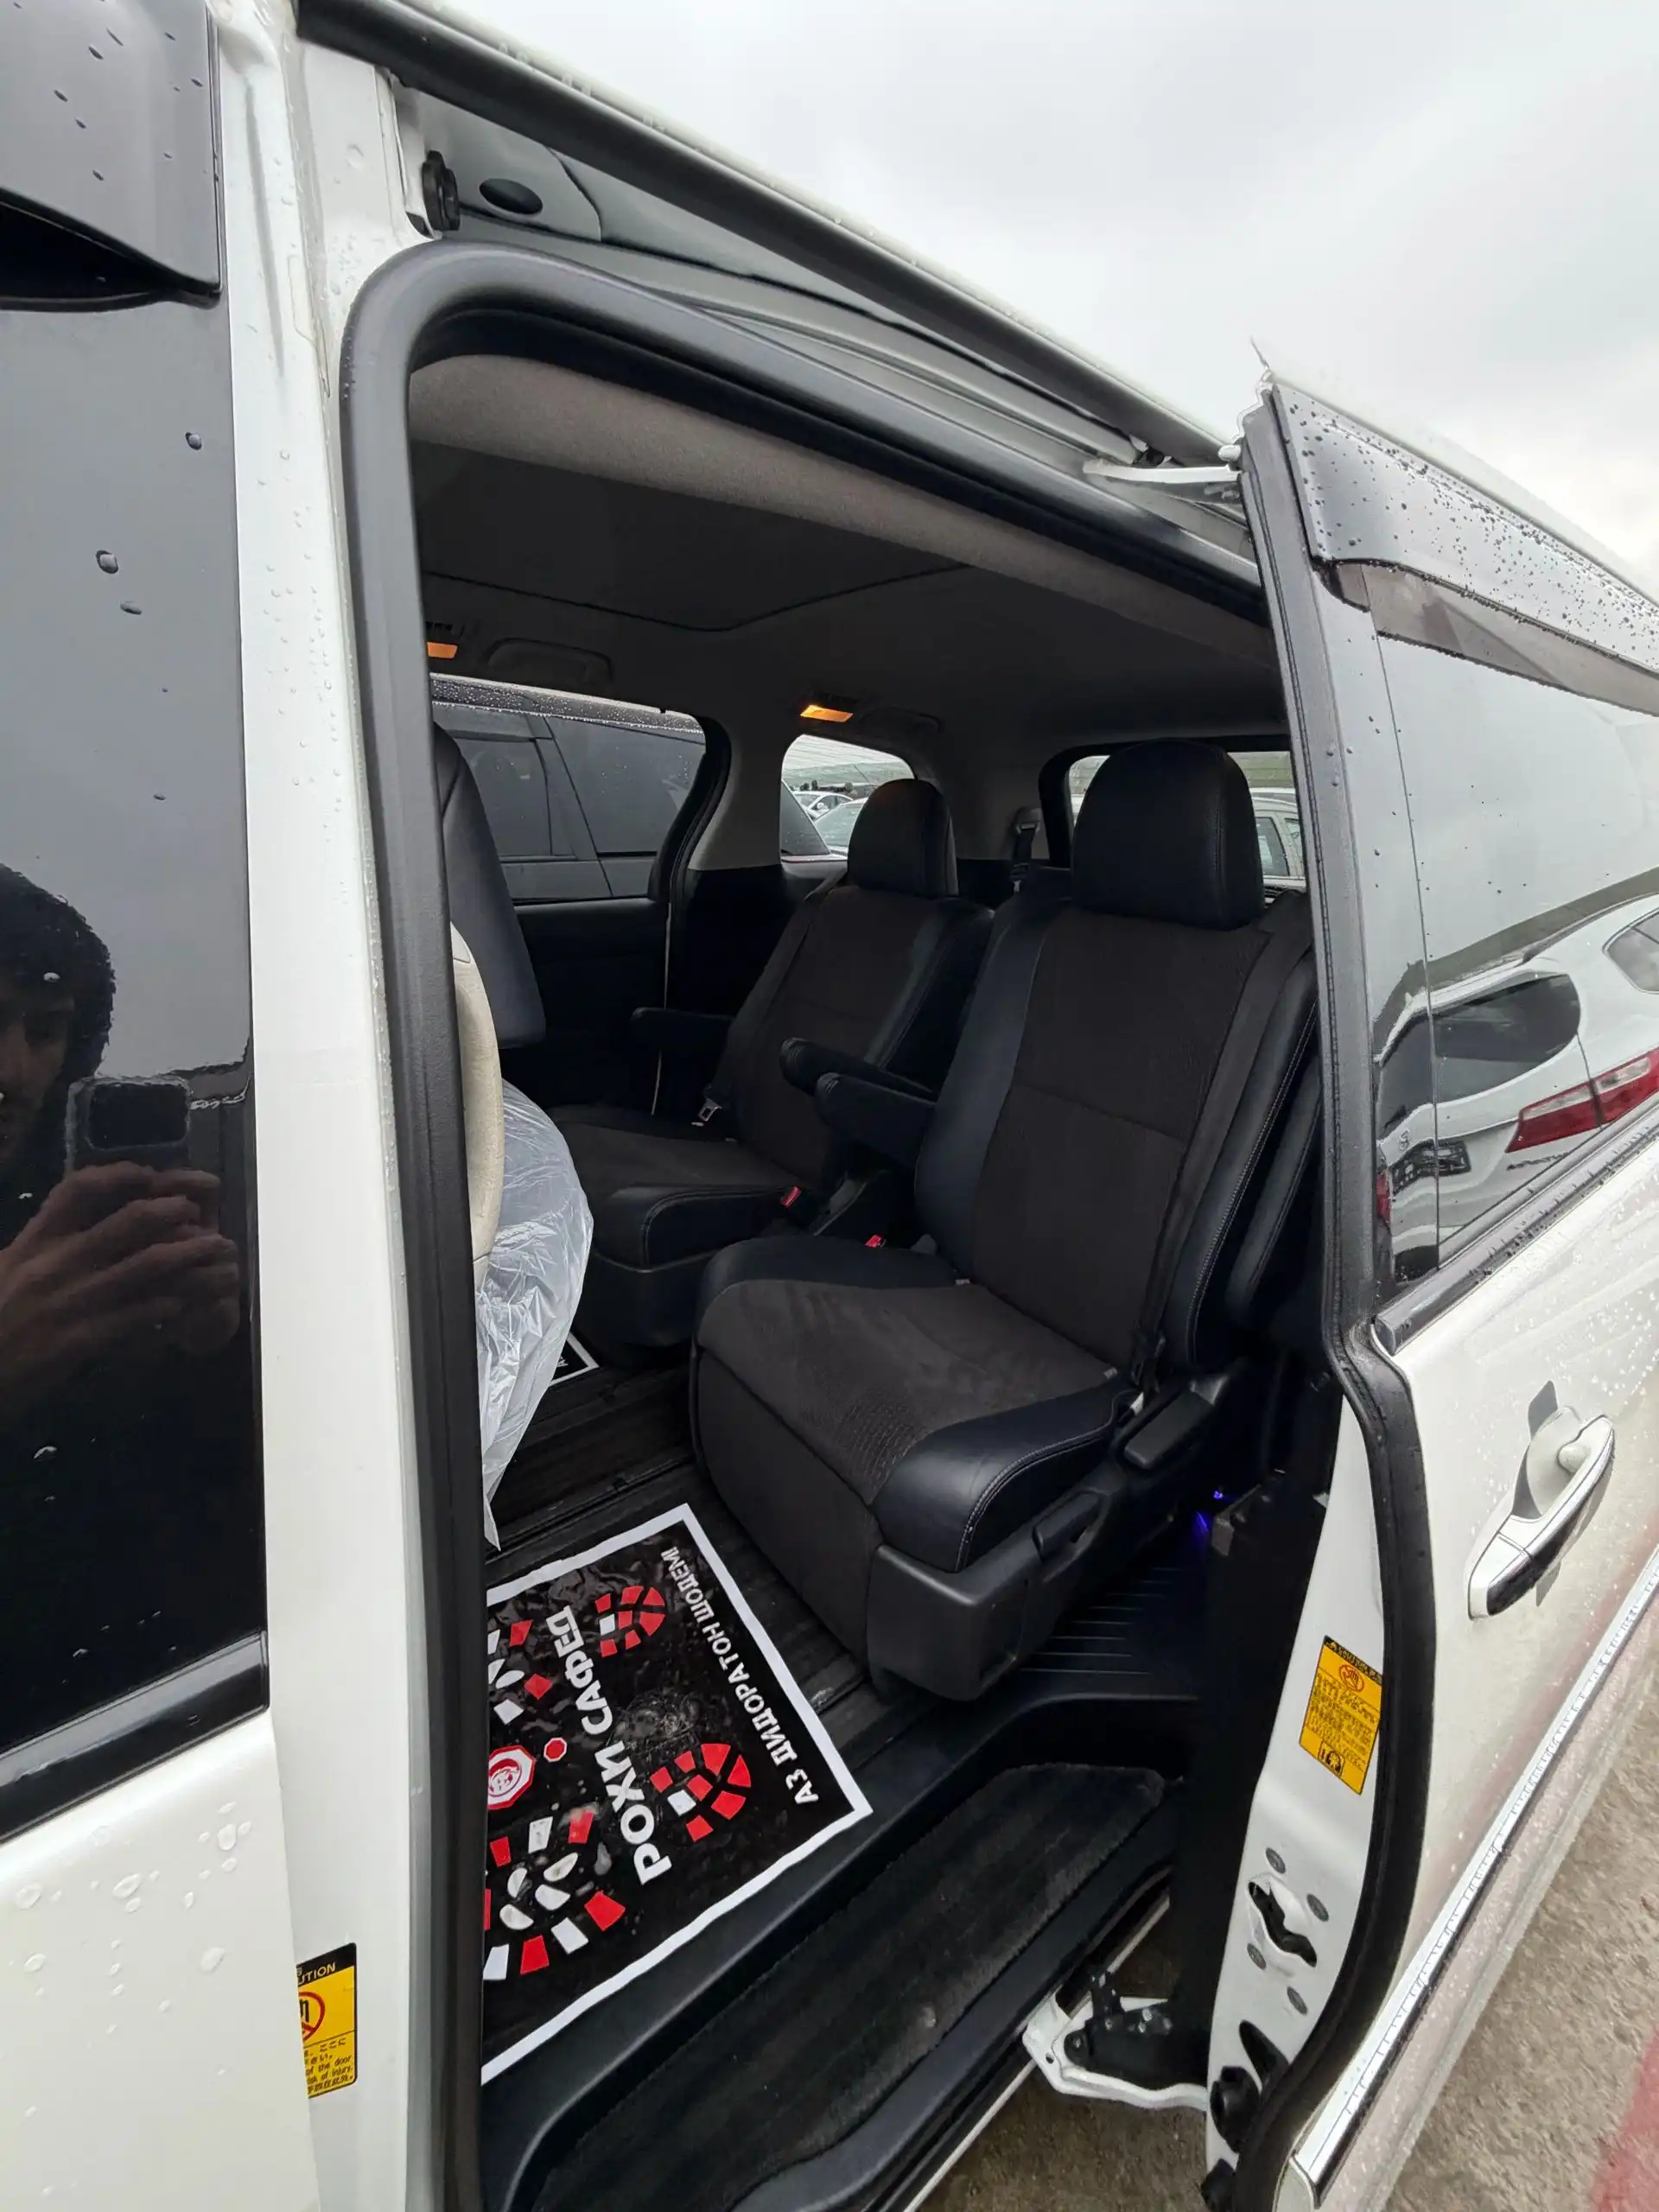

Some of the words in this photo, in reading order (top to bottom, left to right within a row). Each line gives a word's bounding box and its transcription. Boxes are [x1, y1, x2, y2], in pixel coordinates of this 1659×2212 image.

[545, 1605, 613, 1735] САФЕД
[702, 1621, 799, 1766] ДИДОРАТОН
[594, 1740, 672, 1885] РОХИ
[785, 1769, 819, 1805] АЗ
[298, 1962, 335, 1985] UTION
